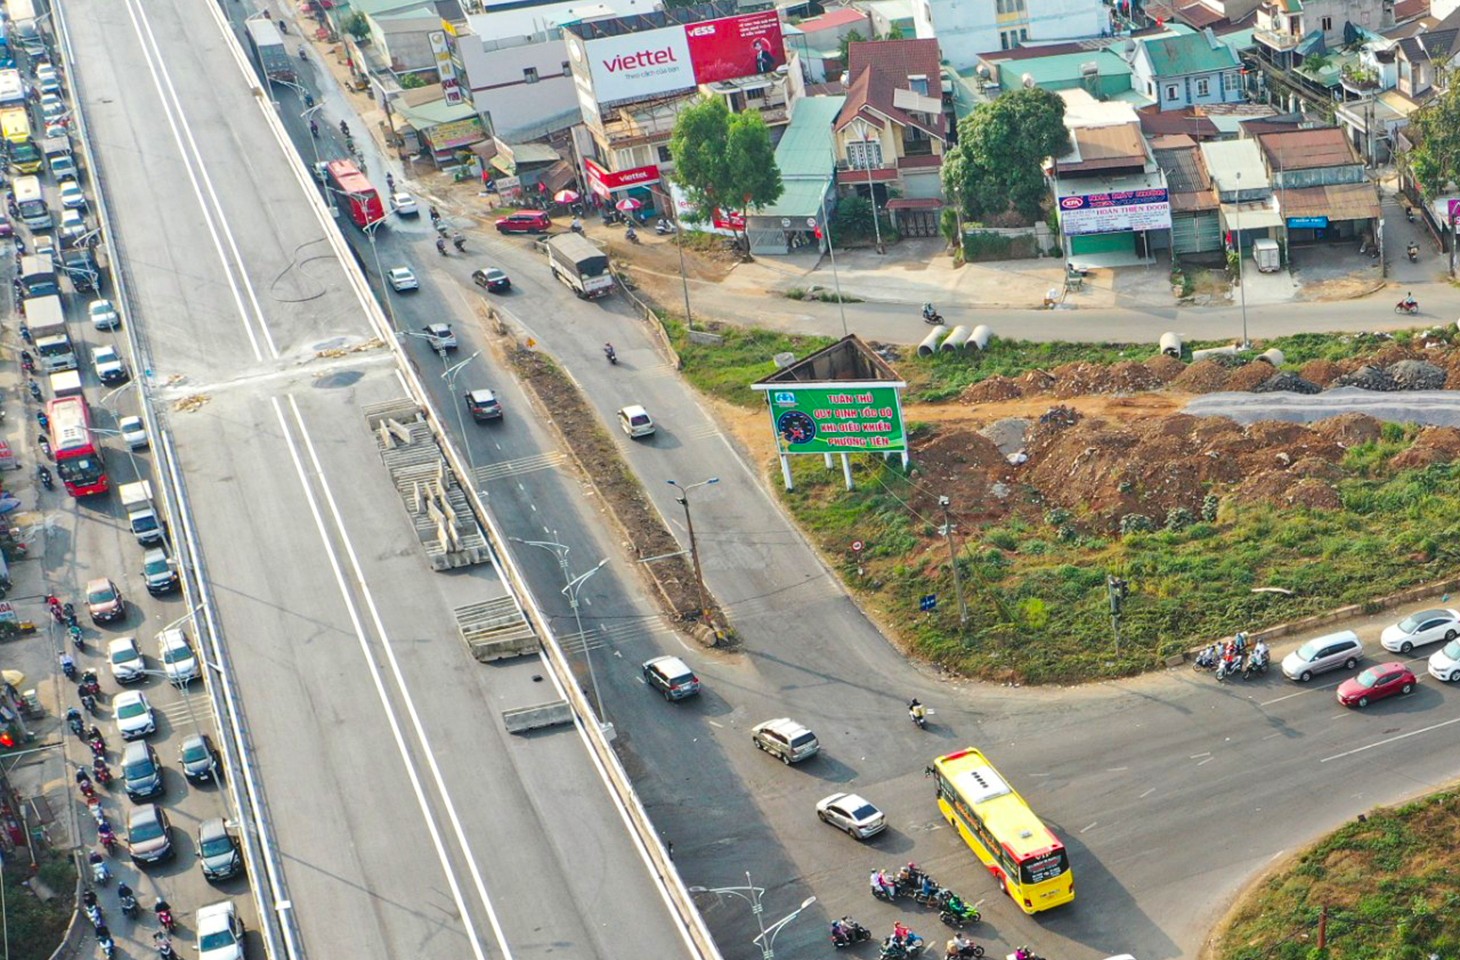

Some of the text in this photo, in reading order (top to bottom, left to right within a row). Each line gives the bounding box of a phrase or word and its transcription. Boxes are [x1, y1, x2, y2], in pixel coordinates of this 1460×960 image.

[602, 46, 678, 73] viettel
[619, 172, 648, 182] viettel
[1146, 203, 1168, 211] DOOR
[813, 408, 832, 418] QUY
[821, 423, 838, 432] KHI
